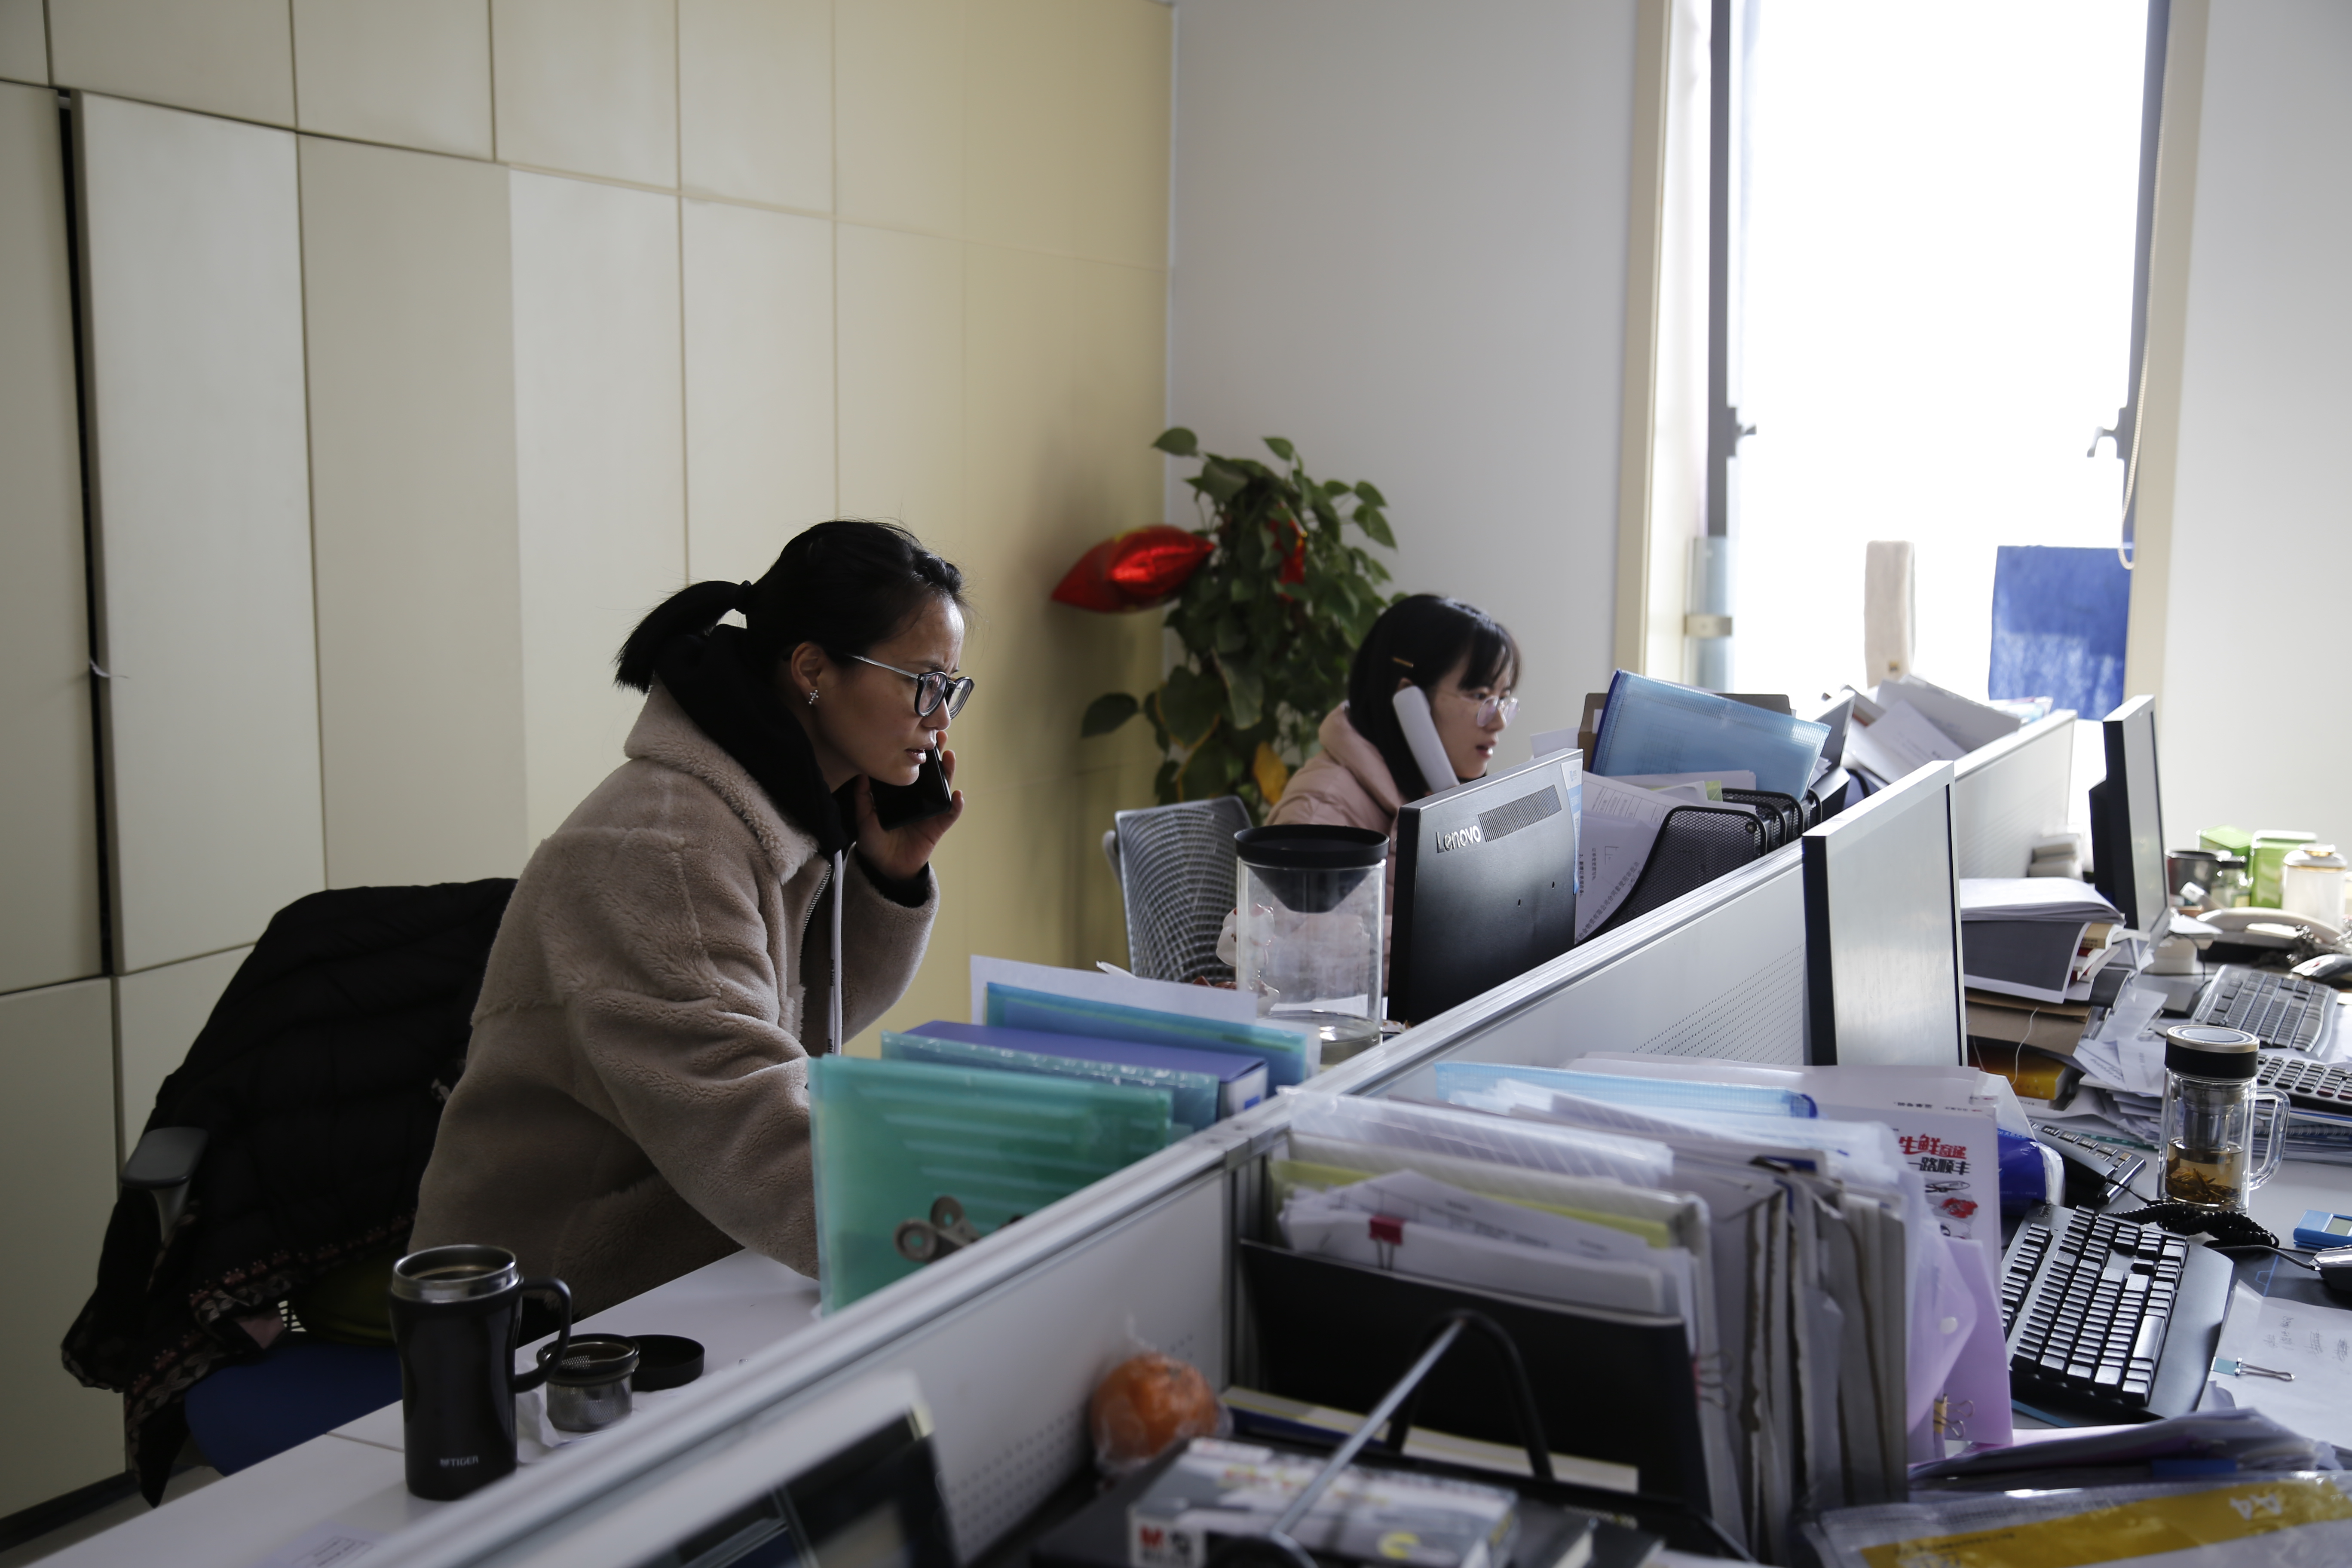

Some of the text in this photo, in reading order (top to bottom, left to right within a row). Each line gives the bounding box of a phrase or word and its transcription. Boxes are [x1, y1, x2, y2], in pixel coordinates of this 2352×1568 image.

[1436, 825, 1481, 853] Lenovo
[1899, 1133, 1967, 1159] 生鲜寄递
[1908, 1157, 1972, 1175] 一路顺丰
[450, 1455, 478, 1466] TIGER
